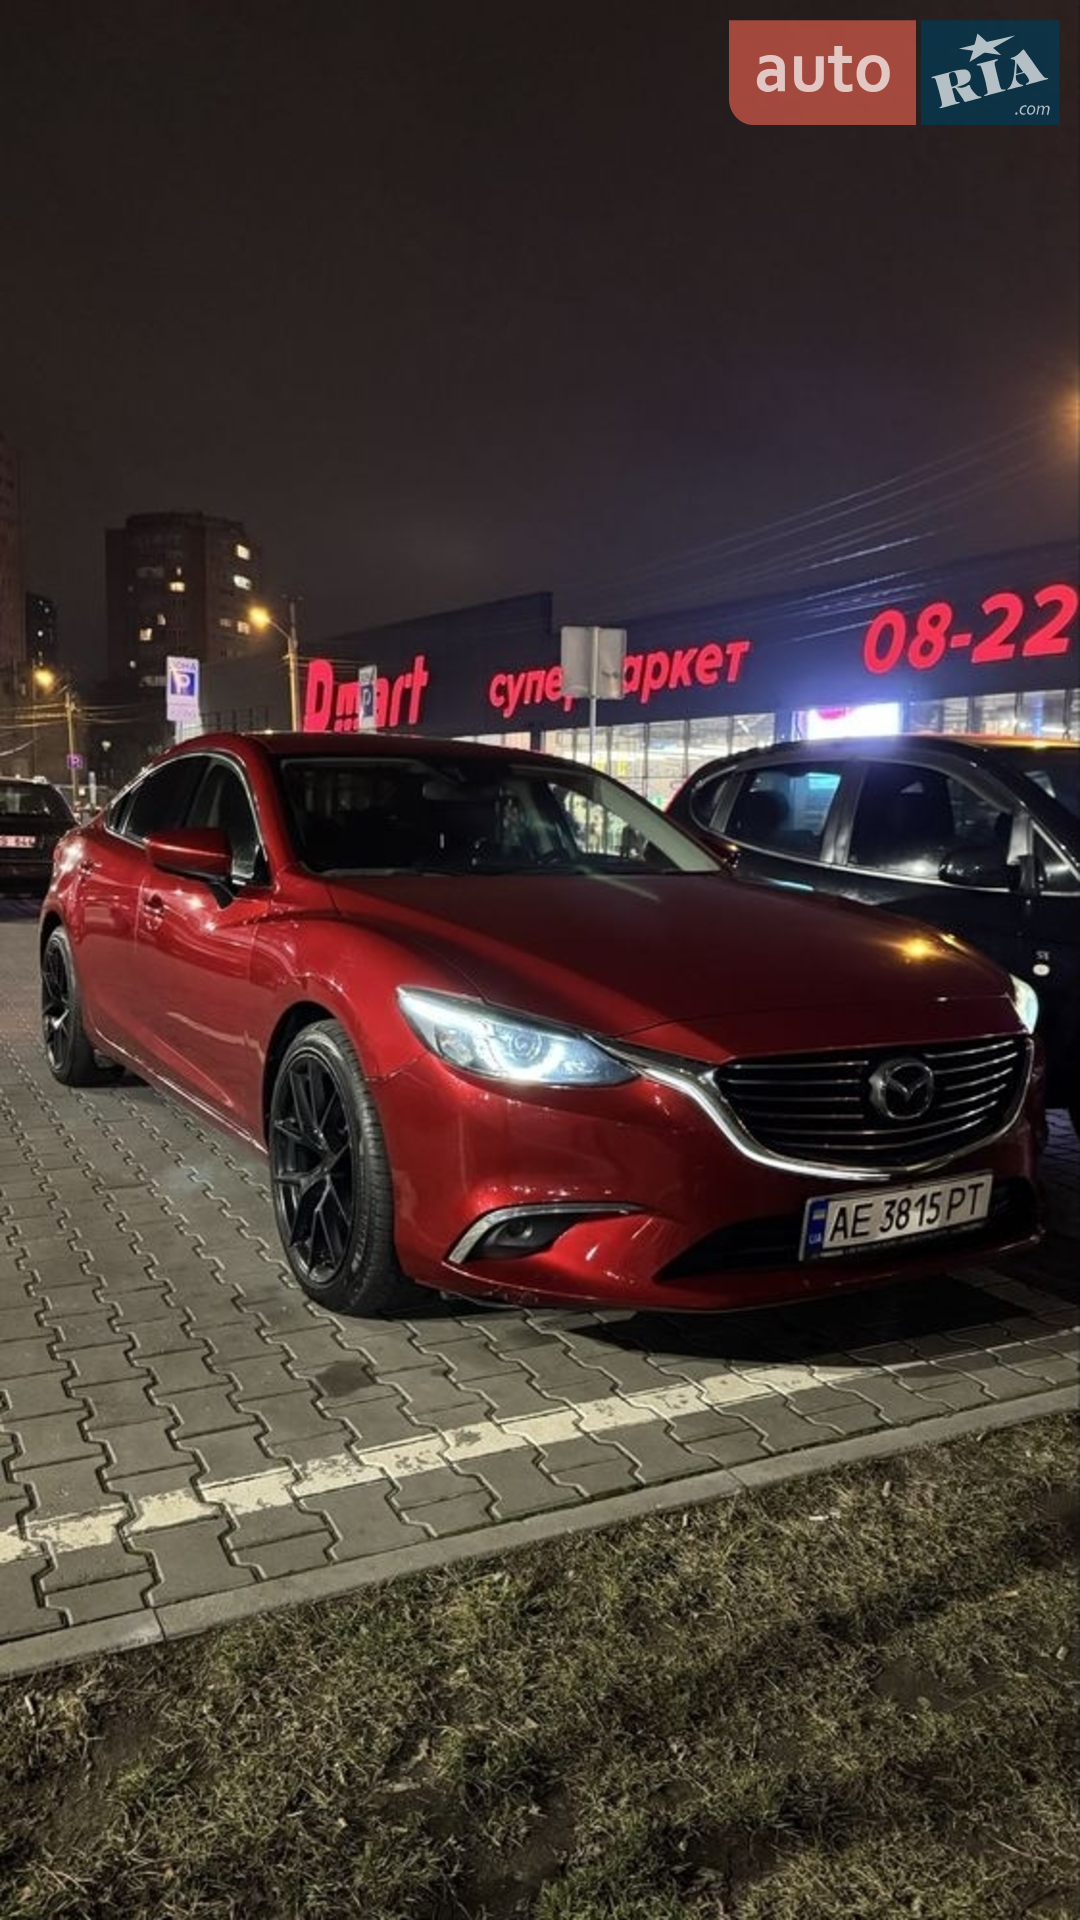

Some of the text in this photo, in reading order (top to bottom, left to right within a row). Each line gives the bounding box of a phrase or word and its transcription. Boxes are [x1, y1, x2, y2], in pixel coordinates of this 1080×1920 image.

[863, 583, 1080, 675] 08-22
[488, 640, 751, 718] супеаркет
[829, 1183, 985, 1241] AE 3815 PT
